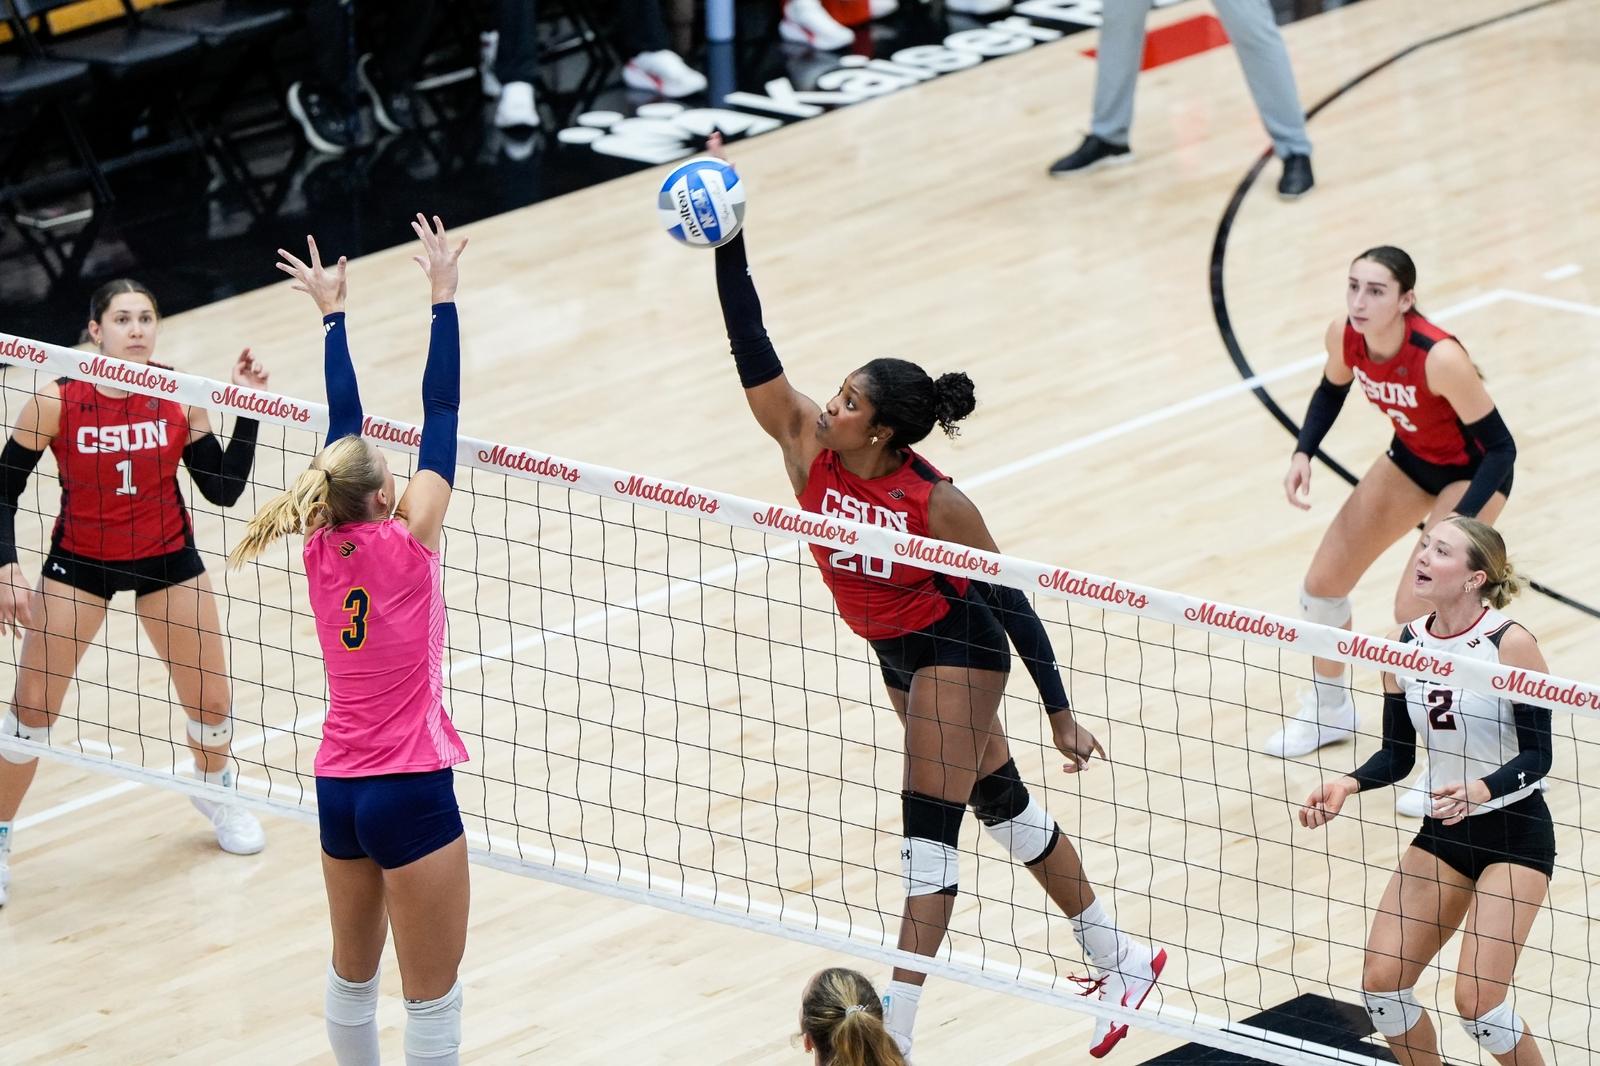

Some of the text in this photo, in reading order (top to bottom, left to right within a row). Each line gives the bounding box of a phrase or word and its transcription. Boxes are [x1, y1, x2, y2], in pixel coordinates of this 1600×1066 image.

[724, 16, 1064, 118] Kaiser
[677, 190, 702, 238] molten
[76, 419, 169, 454] CSUN
[115, 459, 138, 496] 1
[0, 339, 48, 364] dors
[78, 356, 178, 394] Matadors
[211, 385, 310, 423] Matadors
[478, 444, 580, 483] Matadors
[614, 475, 720, 514] Matadors
[753, 506, 859, 545] Matadors
[894, 537, 1002, 576] Matadors
[1038, 569, 1149, 609] Matadors
[1184, 602, 1299, 643] Matadors
[1337, 636, 1455, 677] Matadors
[1492, 670, 1600, 710] Matador
[821, 487, 909, 533] CSUN
[340, 585, 371, 652] 3
[1427, 689, 1457, 731] 2
